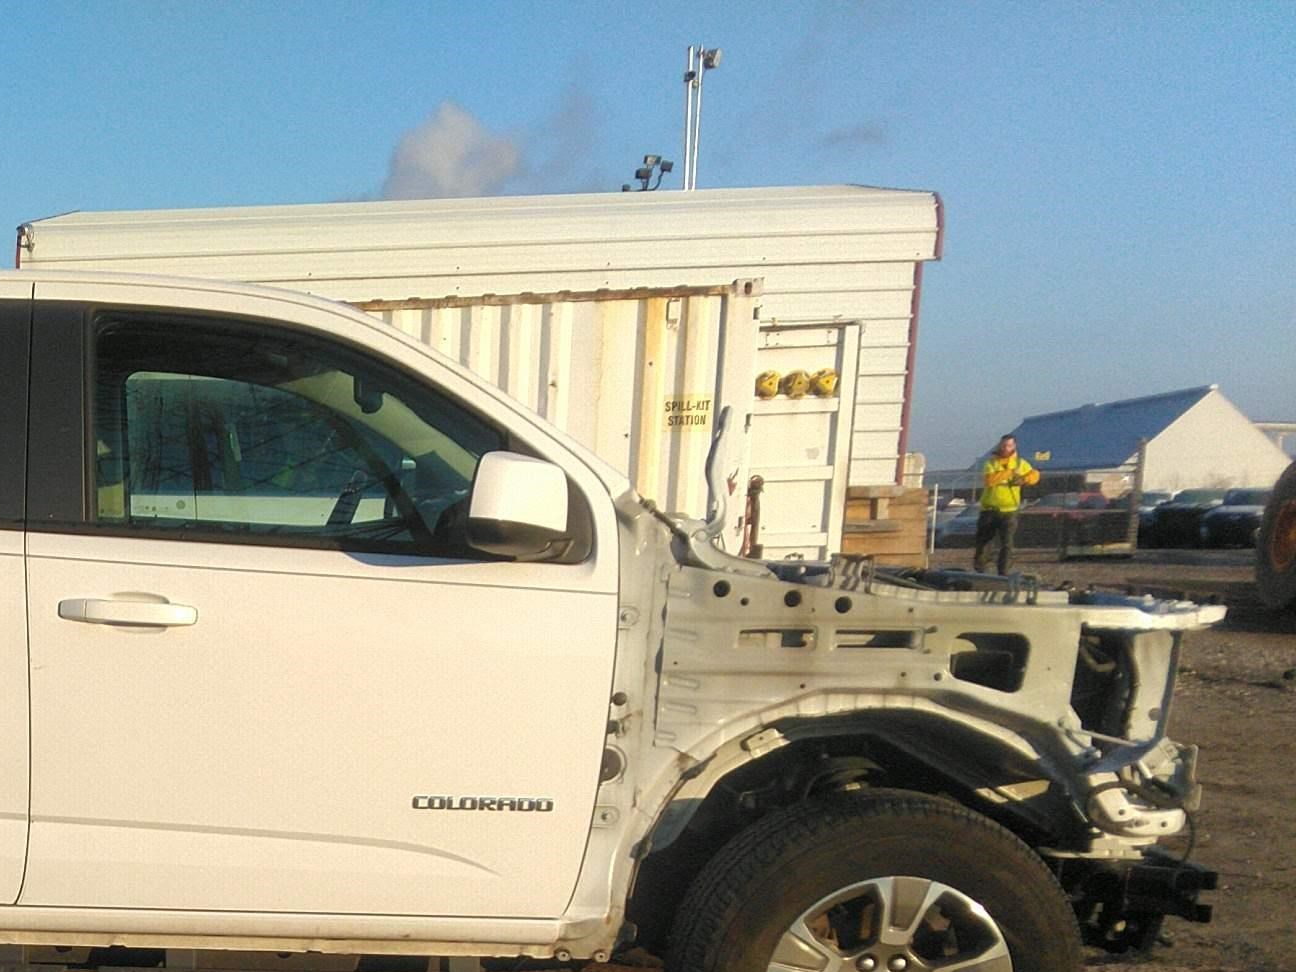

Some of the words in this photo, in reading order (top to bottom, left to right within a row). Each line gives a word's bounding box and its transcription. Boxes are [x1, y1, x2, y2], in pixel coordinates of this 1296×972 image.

[665, 399, 711, 412] SPILL-KIT
[667, 414, 706, 426] STATION
[411, 795, 554, 812] COLORADO
